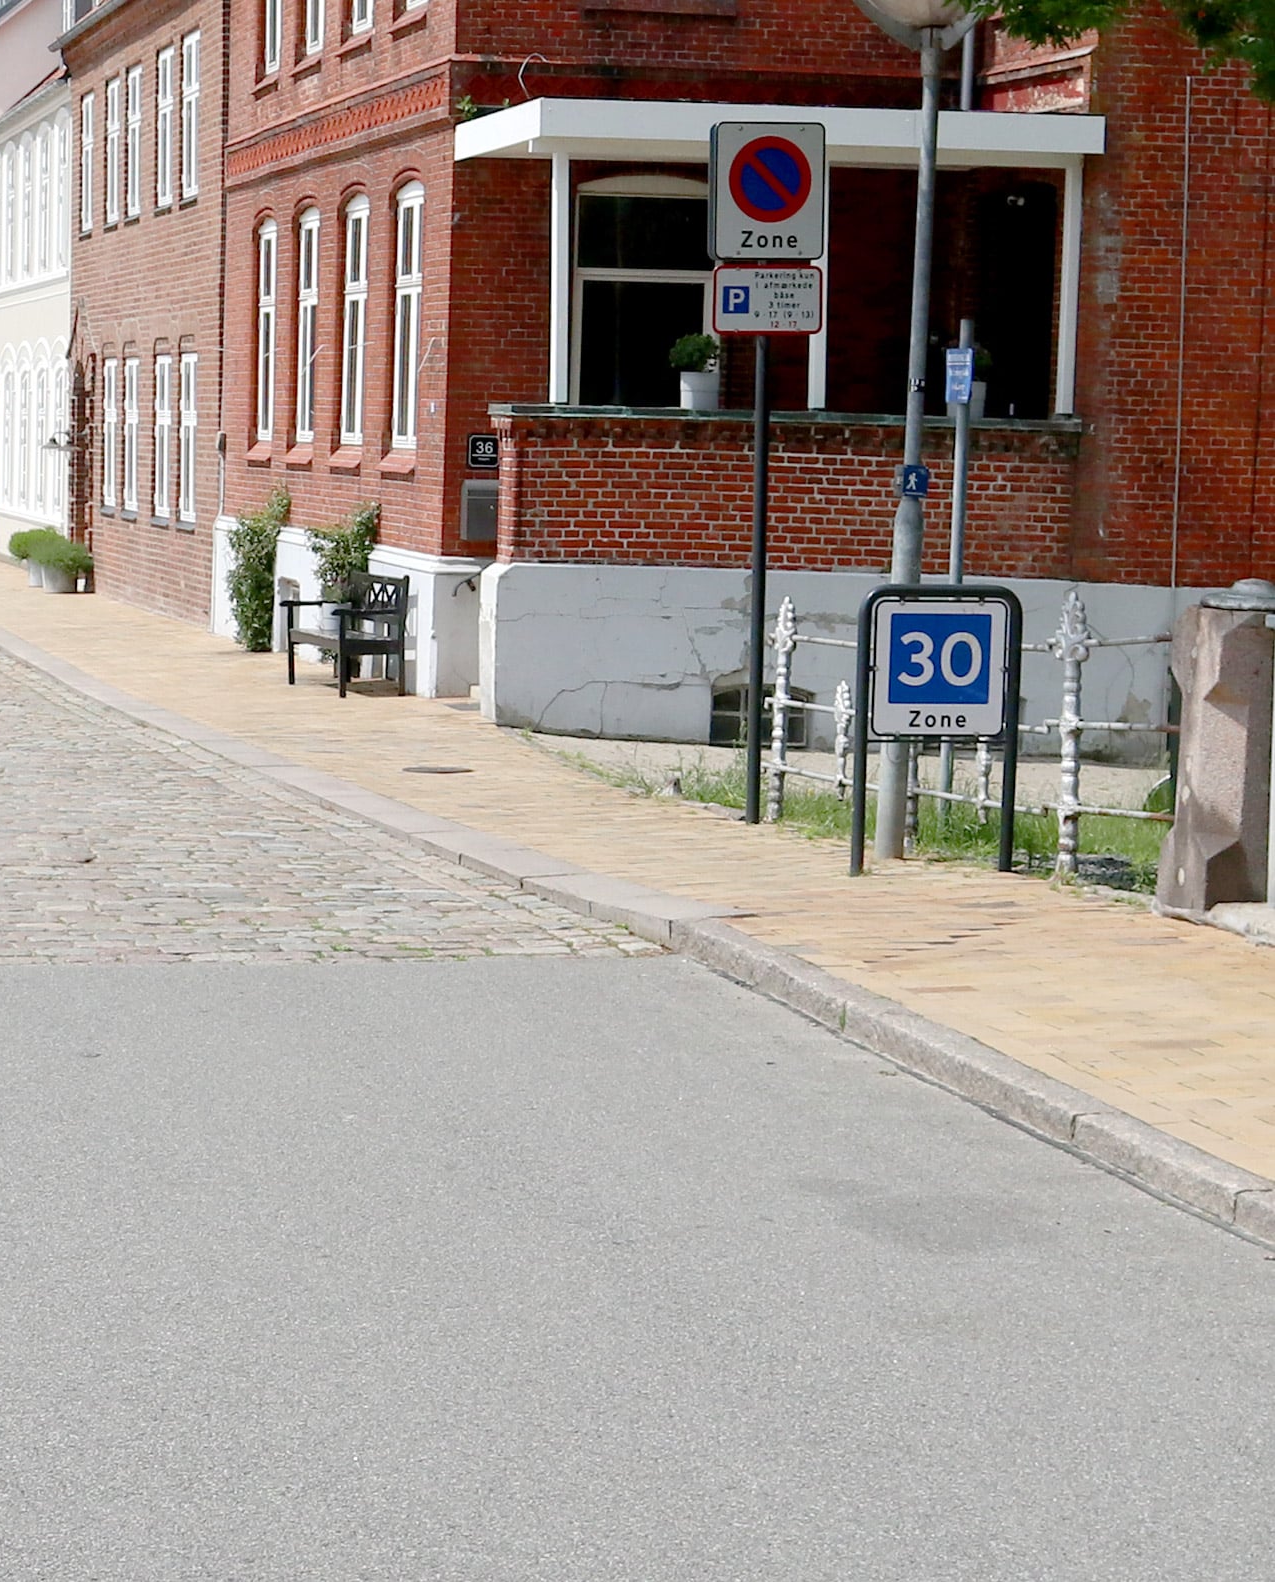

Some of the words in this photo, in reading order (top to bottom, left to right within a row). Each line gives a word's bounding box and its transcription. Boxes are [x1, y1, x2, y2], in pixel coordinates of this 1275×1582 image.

[741, 230, 798, 248] Zone
[754, 271, 796, 280] Parkering
[799, 271, 815, 279] kun
[728, 288, 745, 311] P
[774, 291, 795, 299] båse
[768, 301, 774, 309] 3
[777, 301, 801, 309] timer
[754, 310, 760, 318] 9
[769, 311, 778, 319] 17
[770, 321, 780, 329] 12
[788, 321, 798, 329] 17
[476, 441, 493, 454] 36
[897, 631, 982, 687] 30
[909, 710, 966, 728] Zone
